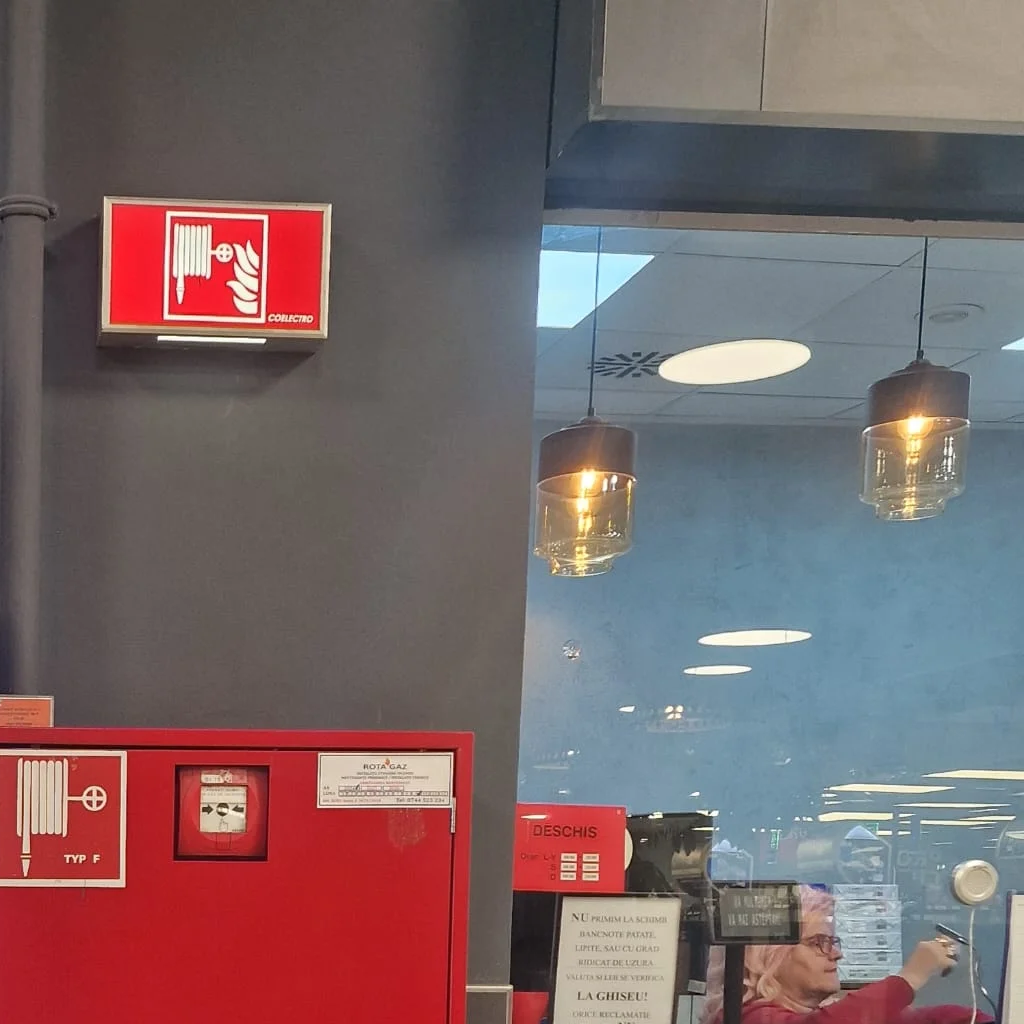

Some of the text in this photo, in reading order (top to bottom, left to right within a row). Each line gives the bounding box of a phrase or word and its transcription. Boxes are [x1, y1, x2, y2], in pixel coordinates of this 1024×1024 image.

[267, 313, 313, 324] COELECTRO
[533, 824, 597, 838] DESCHIS
[64, 854, 101, 864] TYP F
[571, 912, 589, 923] NU
[577, 991, 648, 1001] LA GHISEU!
